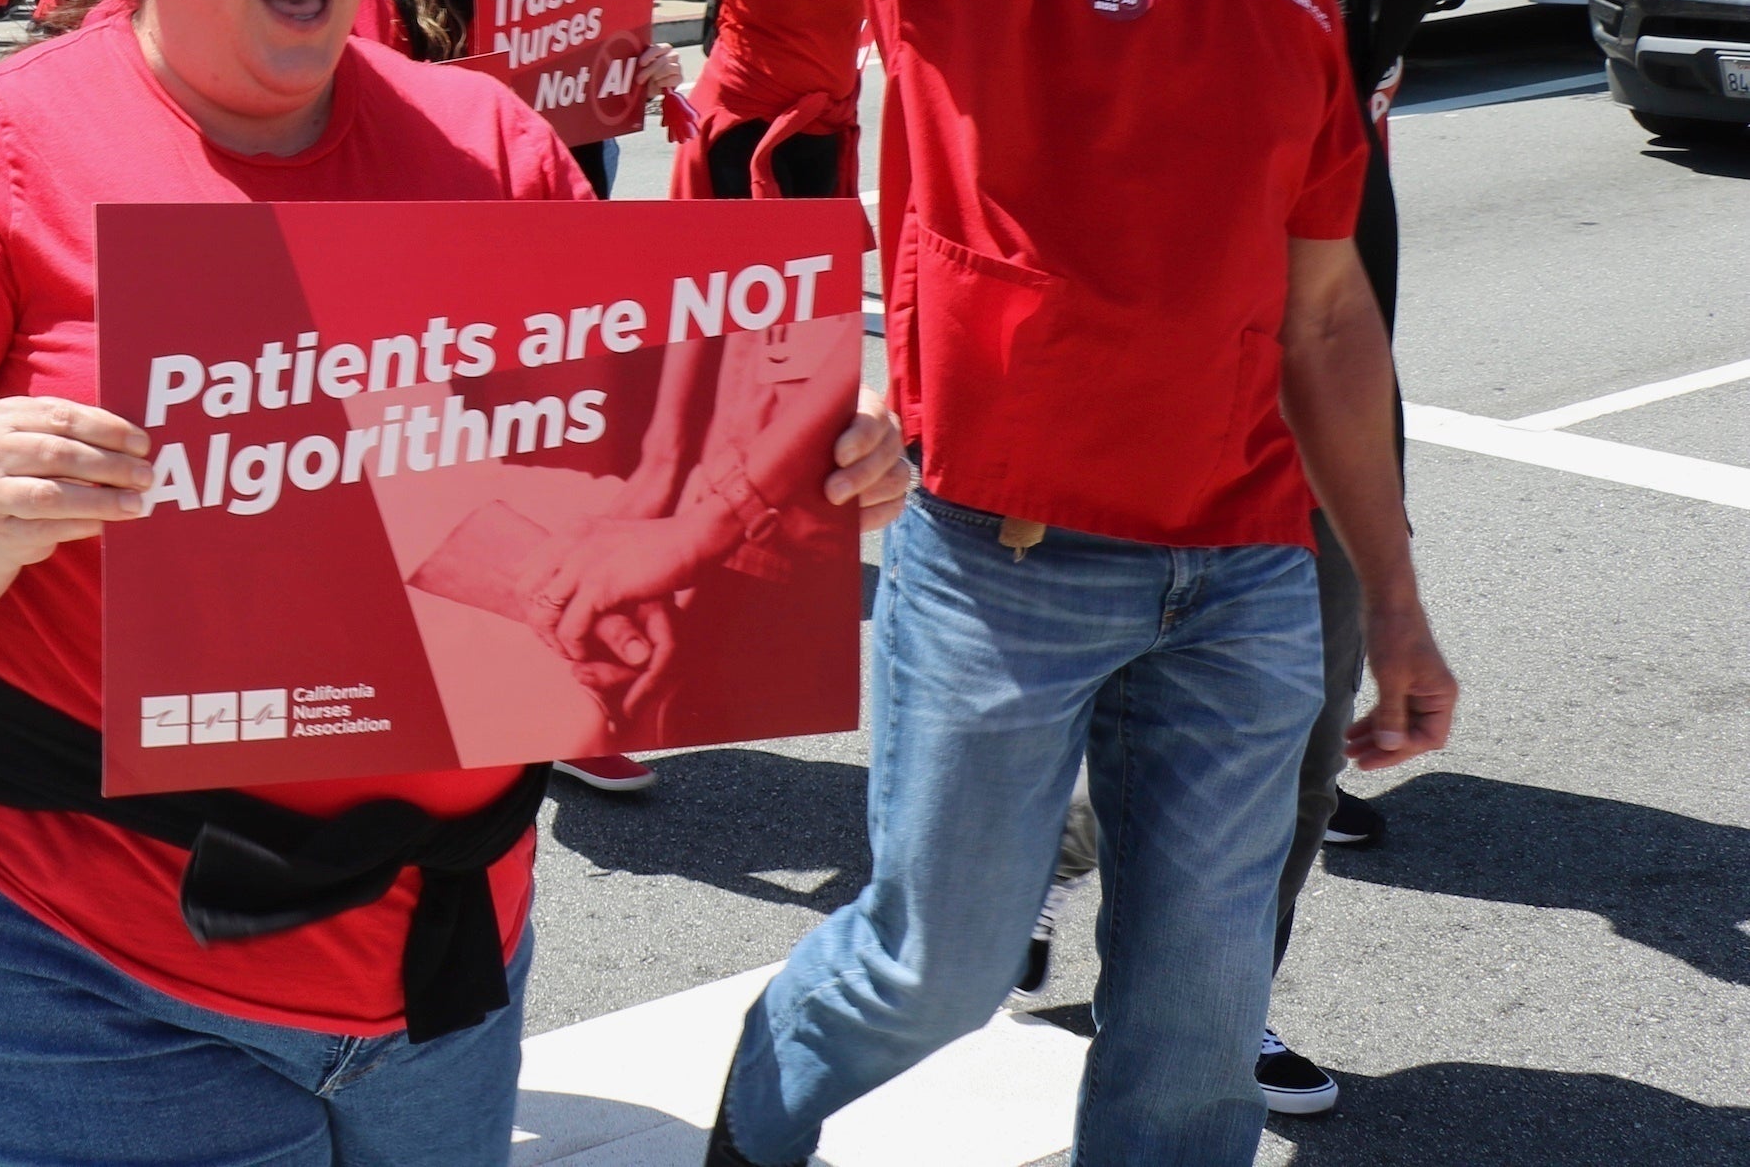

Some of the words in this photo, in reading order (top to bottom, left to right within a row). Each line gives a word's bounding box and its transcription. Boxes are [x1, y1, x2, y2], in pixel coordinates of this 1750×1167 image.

[494, 7, 603, 69] Nurses
[534, 66, 590, 112] Not
[598, 57, 638, 99] AI
[143, 316, 497, 428] Patients
[517, 299, 647, 369] are
[669, 254, 833, 345] NOT
[139, 386, 608, 517] Algorithms
[292, 683, 375, 702] California
[292, 702, 352, 720] Nurses
[292, 717, 392, 737] Association
